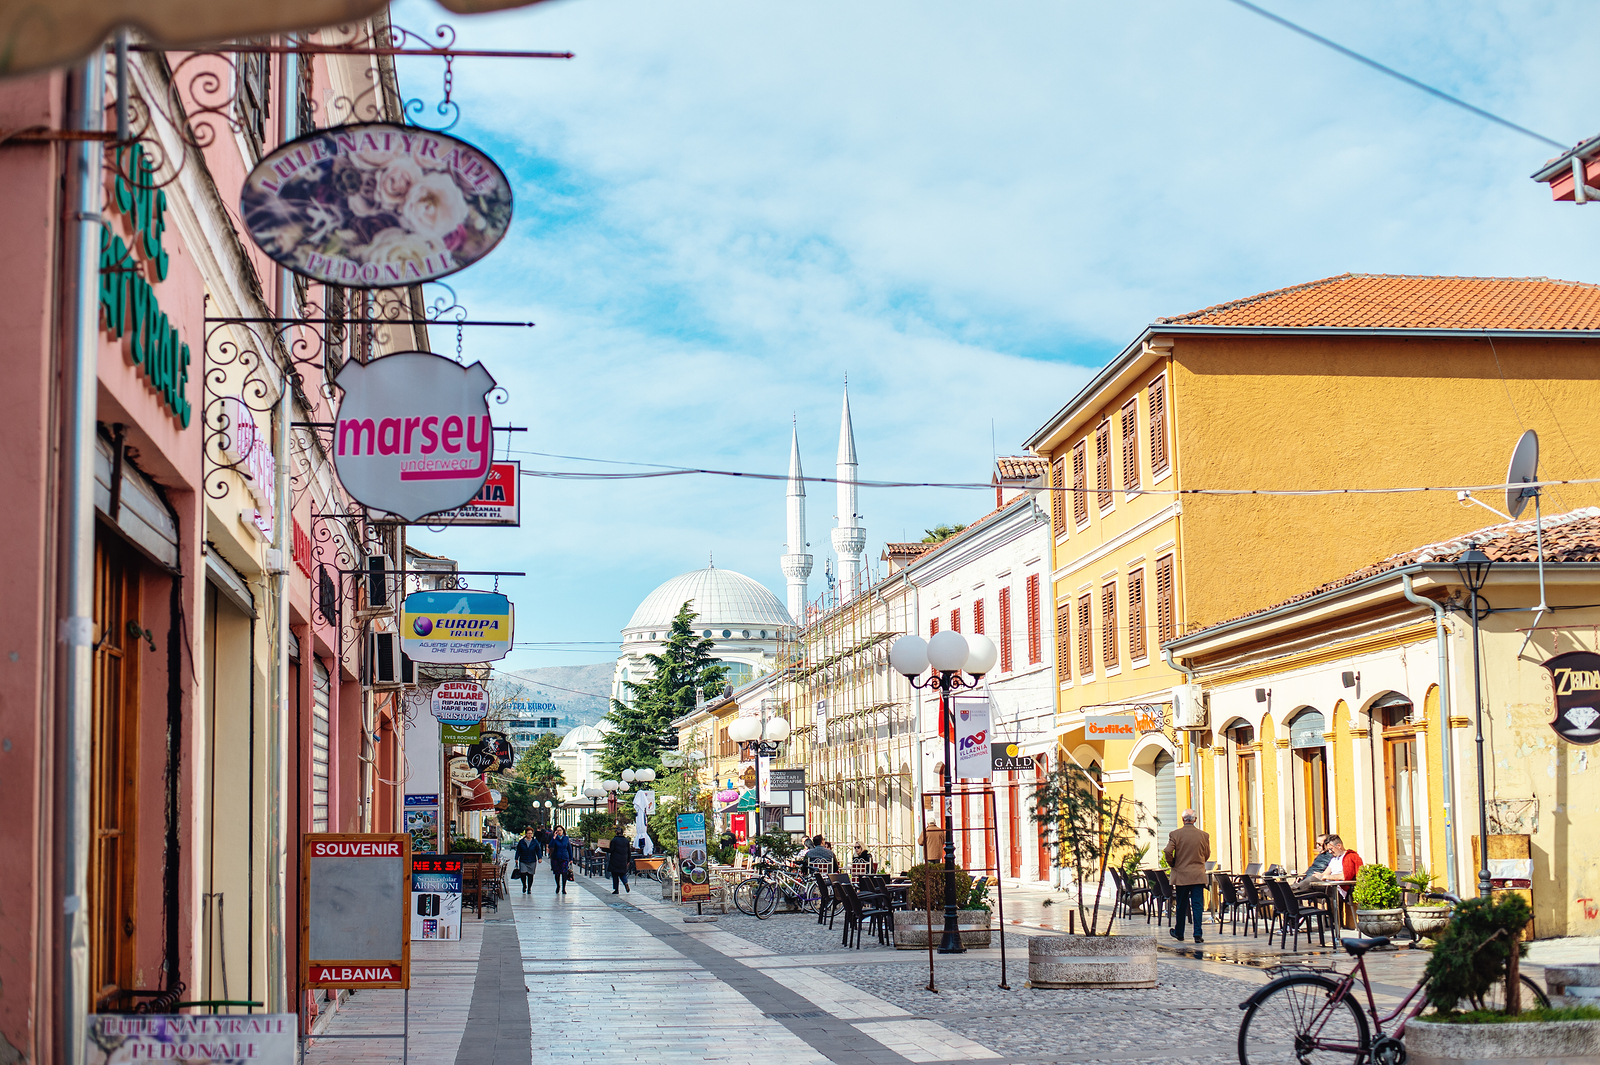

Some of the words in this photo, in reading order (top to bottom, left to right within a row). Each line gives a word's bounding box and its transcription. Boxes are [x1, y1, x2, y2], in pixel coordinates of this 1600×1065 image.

[260, 138, 329, 195] LULE
[335, 131, 496, 193] NATYRALE
[305, 252, 454, 282] PEDONALE
[338, 414, 490, 481] marsey
[400, 454, 474, 471] underwear
[435, 618, 499, 630] EUROPA
[449, 630, 485, 638] TRAVEL
[443, 683, 478, 691] SERVIS
[437, 691, 483, 700] CELULARË
[528, 702, 557, 710] EUROPA
[1089, 722, 1133, 734] Özdilek
[994, 757, 1032, 767] GALD
[680, 838, 705, 846] THETH
[315, 843, 399, 856] SOUVENIR
[414, 881, 459, 890] ARISTONI
[319, 968, 393, 981] ALBANIA
[103, 1017, 159, 1036] LULE
[164, 1017, 288, 1036] NATYRALE
[131, 1042, 259, 1061] PEDONALE
